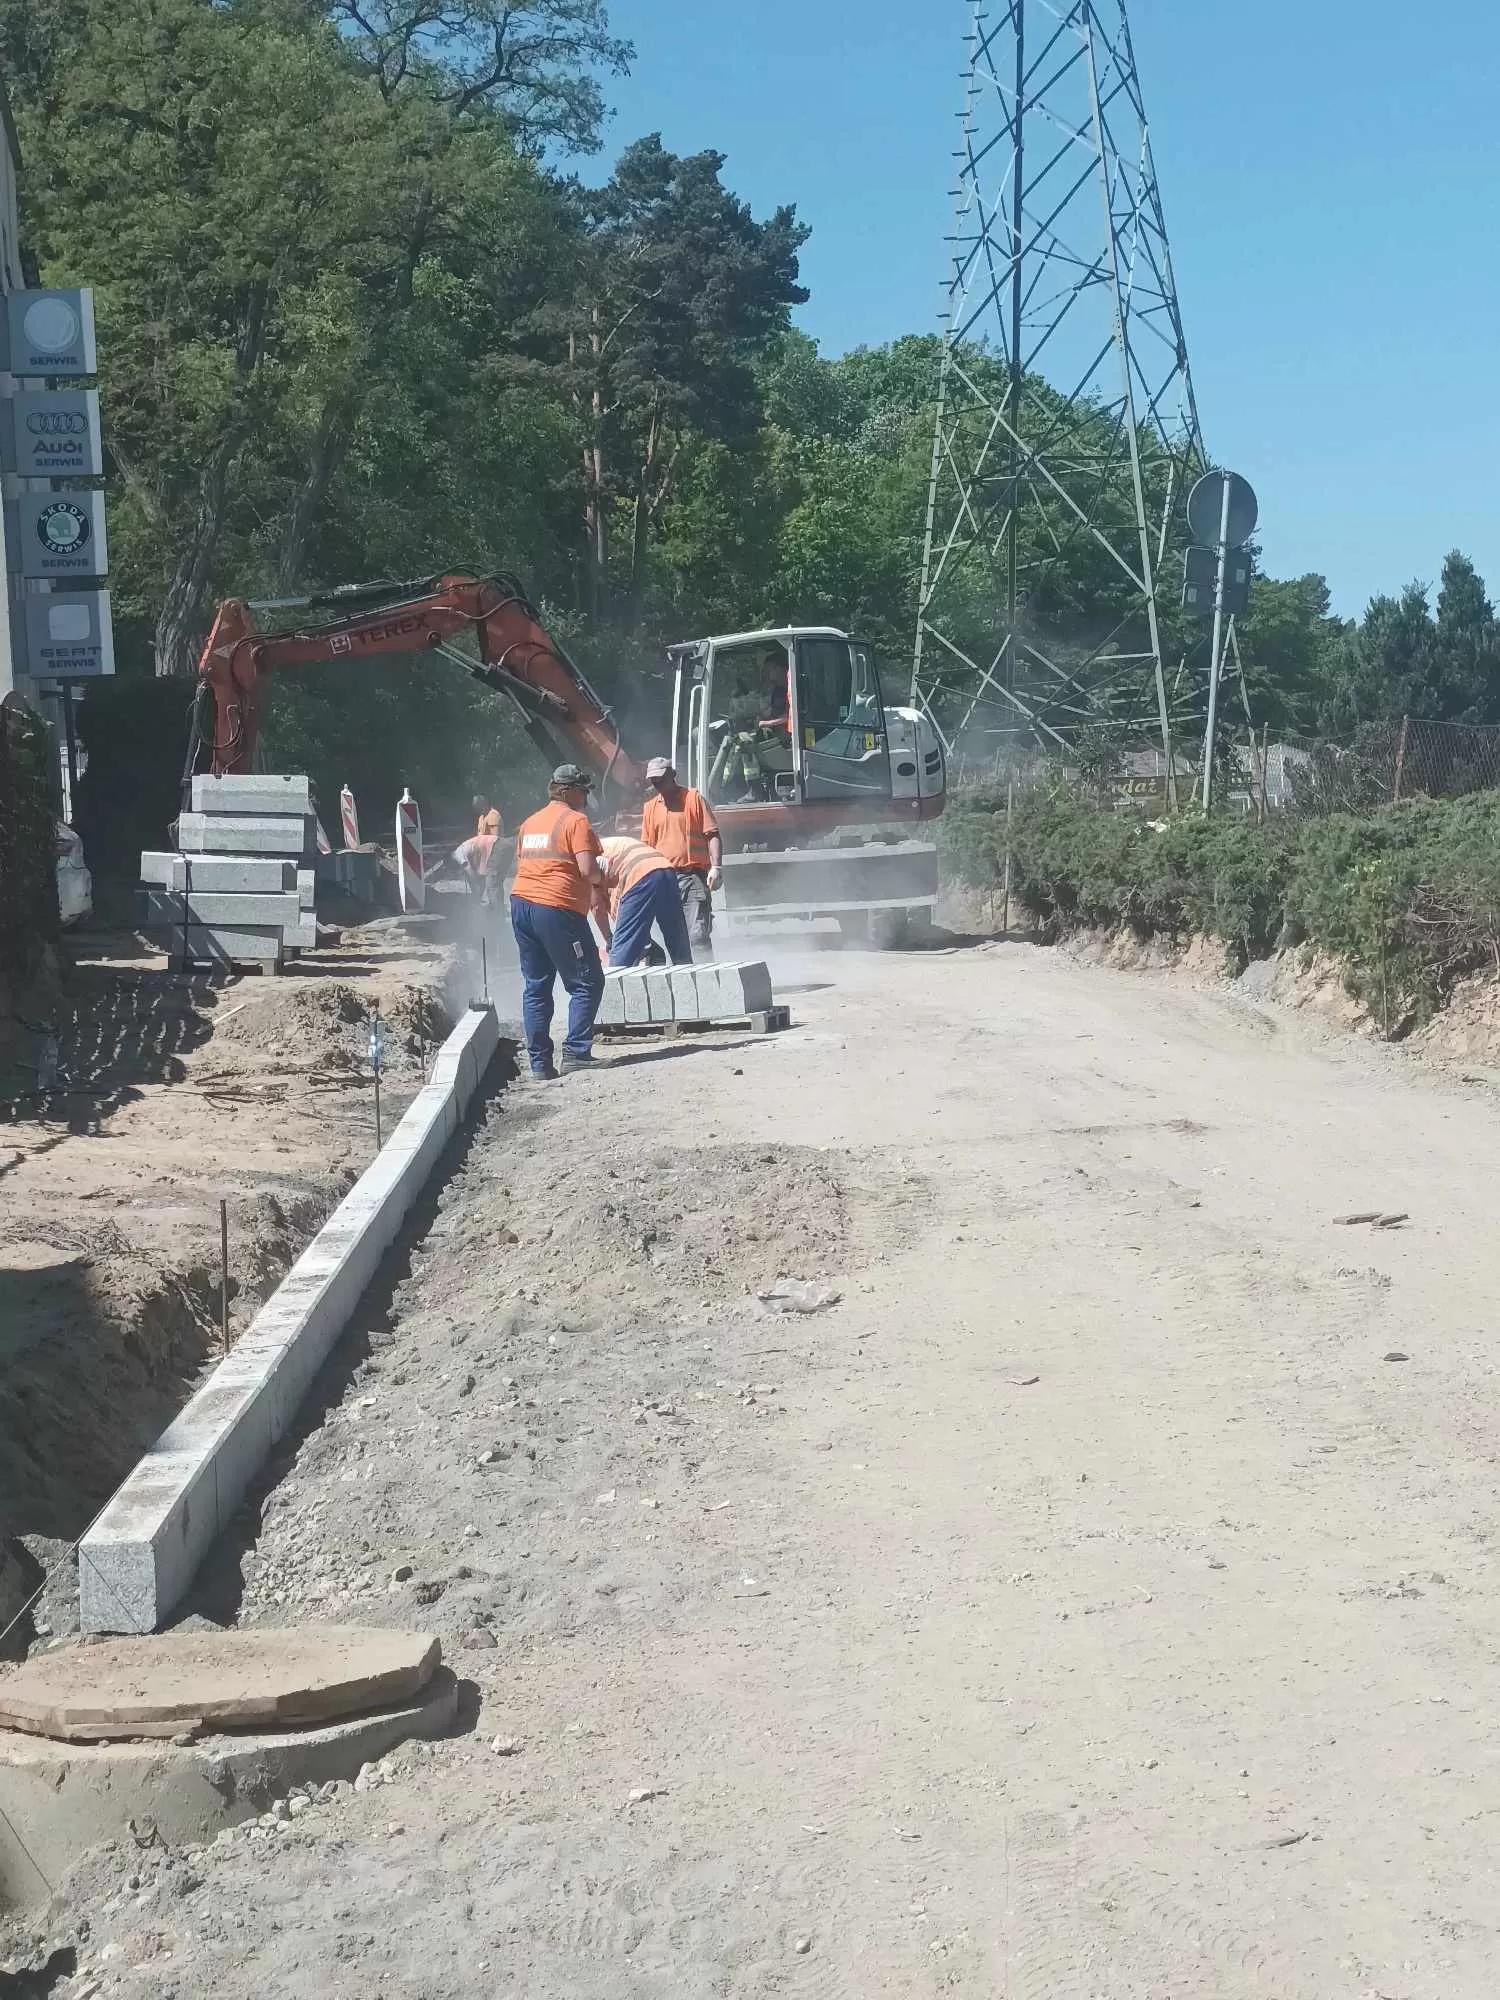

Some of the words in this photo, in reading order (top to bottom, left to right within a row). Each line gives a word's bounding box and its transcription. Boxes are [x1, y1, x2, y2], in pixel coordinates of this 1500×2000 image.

[30, 356, 78, 366] SERWIS
[36, 458, 83, 467] SERWIS
[45, 539, 83, 553] SERWIS
[41, 558, 89, 568] SERWIS
[351, 612, 430, 645] TEREX
[40, 646, 101, 658] SEAT
[48, 658, 96, 669] SERWIS
